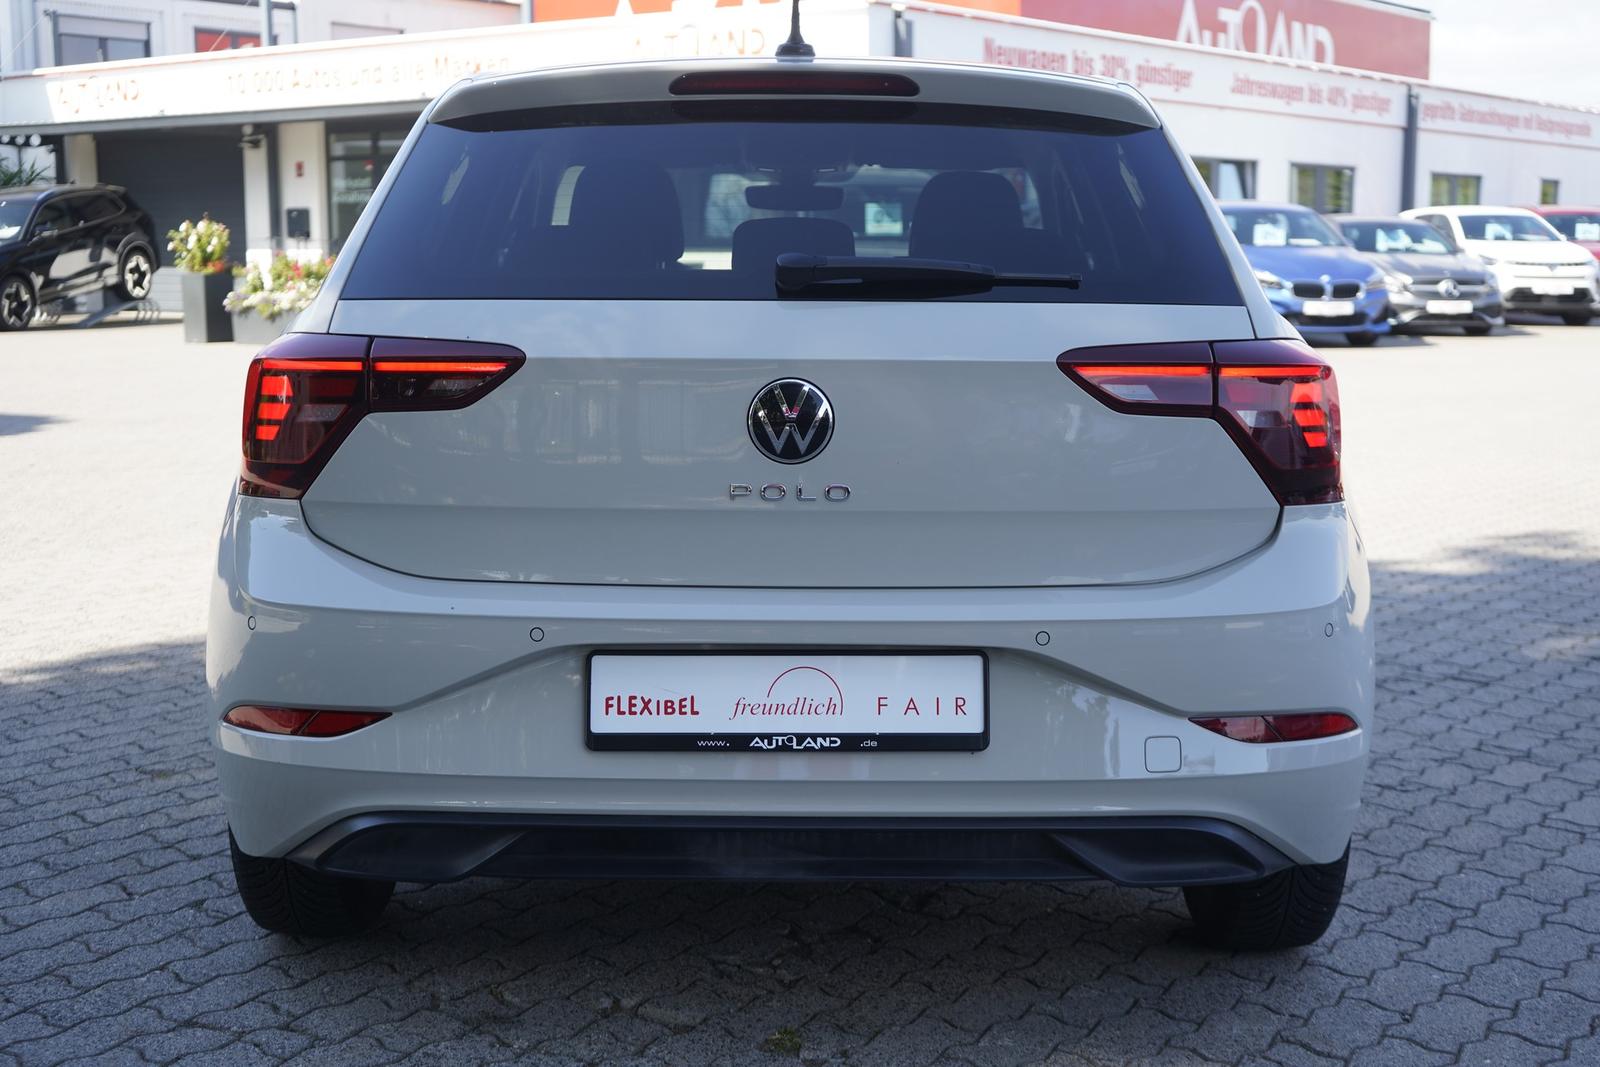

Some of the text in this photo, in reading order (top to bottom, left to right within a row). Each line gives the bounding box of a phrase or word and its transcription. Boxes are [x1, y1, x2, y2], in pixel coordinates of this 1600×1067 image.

[982, 37, 1068, 73] Neuwagen
[1072, 49, 1095, 75] bis
[1135, 59, 1194, 91] günstiger
[730, 484, 851, 501] POLO
[605, 695, 967, 720] FLEXIBEL freundlich FAIR
[749, 735, 841, 749] AUTOLAND
